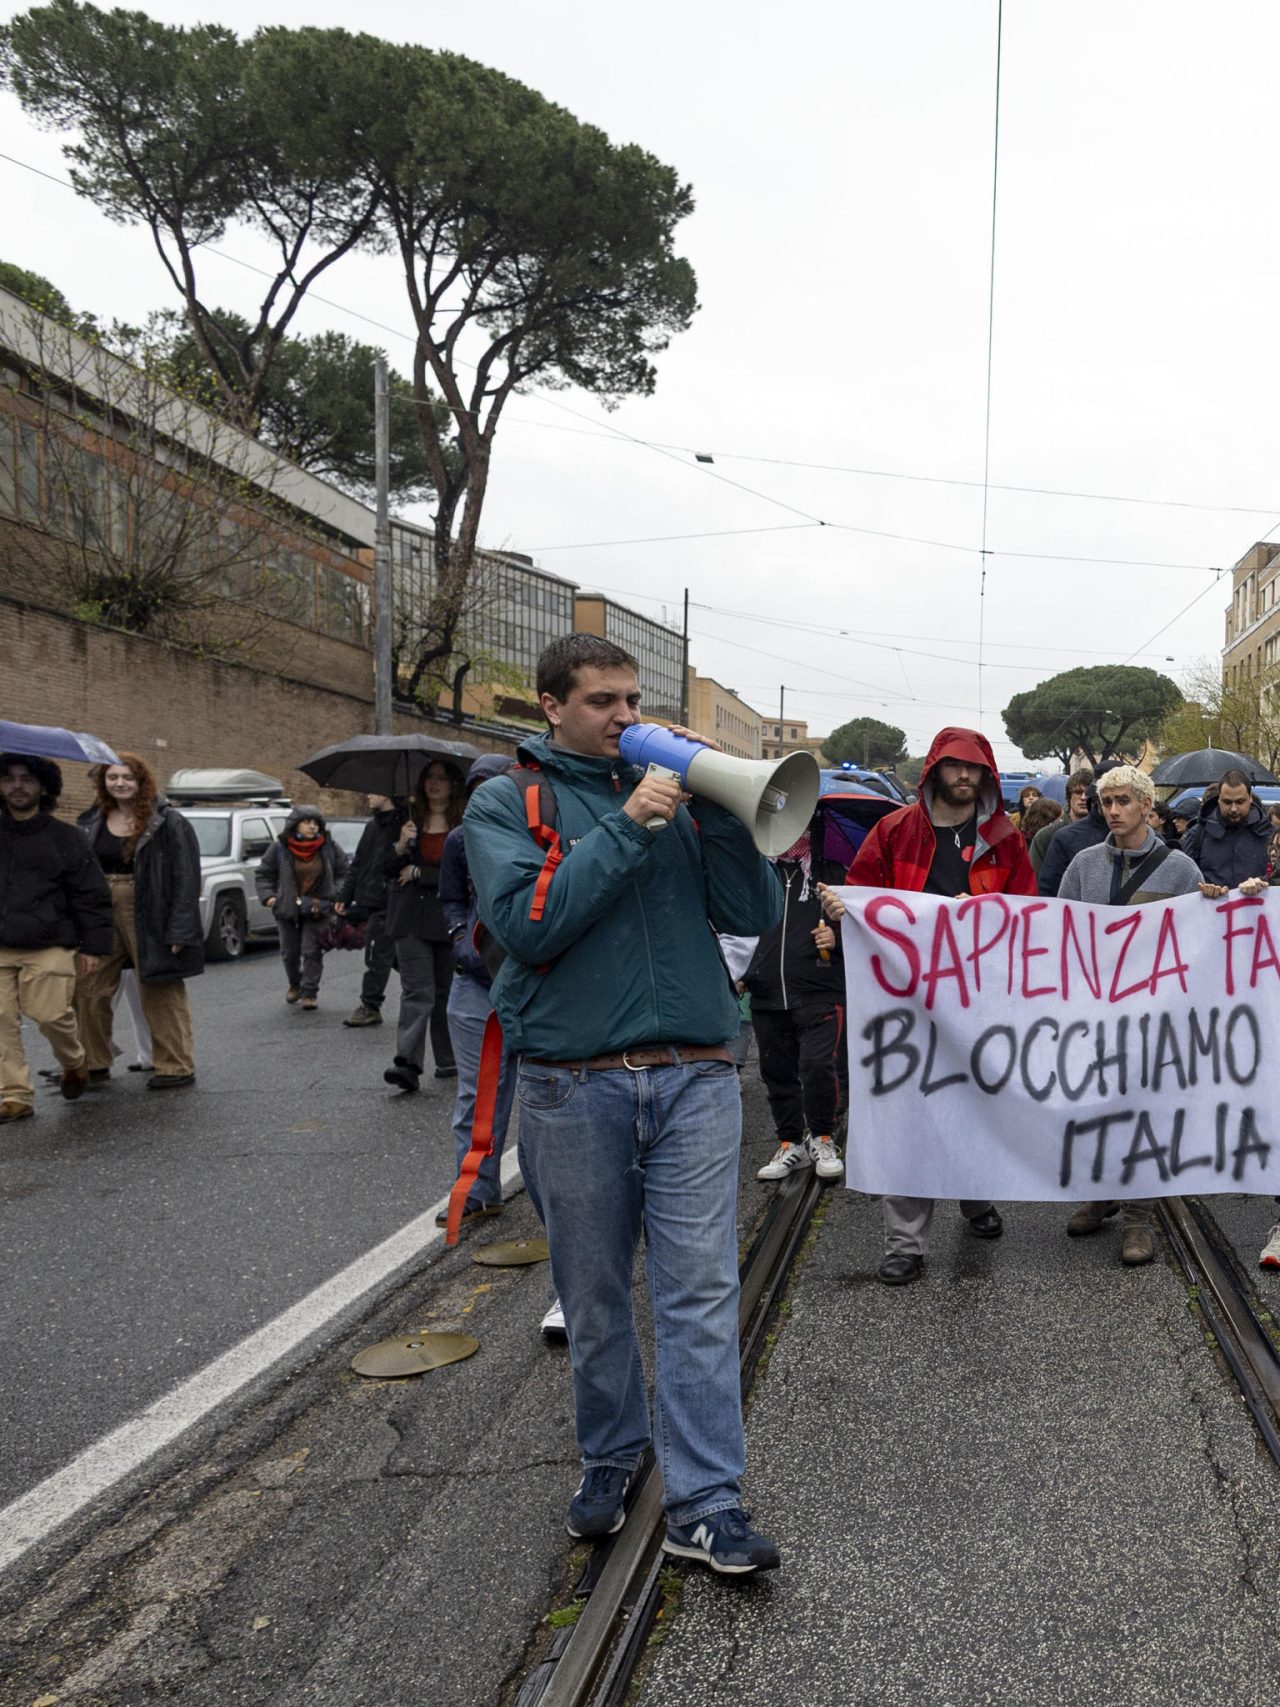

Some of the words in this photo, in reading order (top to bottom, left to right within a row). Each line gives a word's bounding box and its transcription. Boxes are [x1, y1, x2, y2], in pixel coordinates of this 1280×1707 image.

[864, 894, 1188, 1009] SAPIENZA
[861, 1004, 1262, 1101] BLOCCHIAMO
[1059, 1102, 1271, 1188] ITALIA
